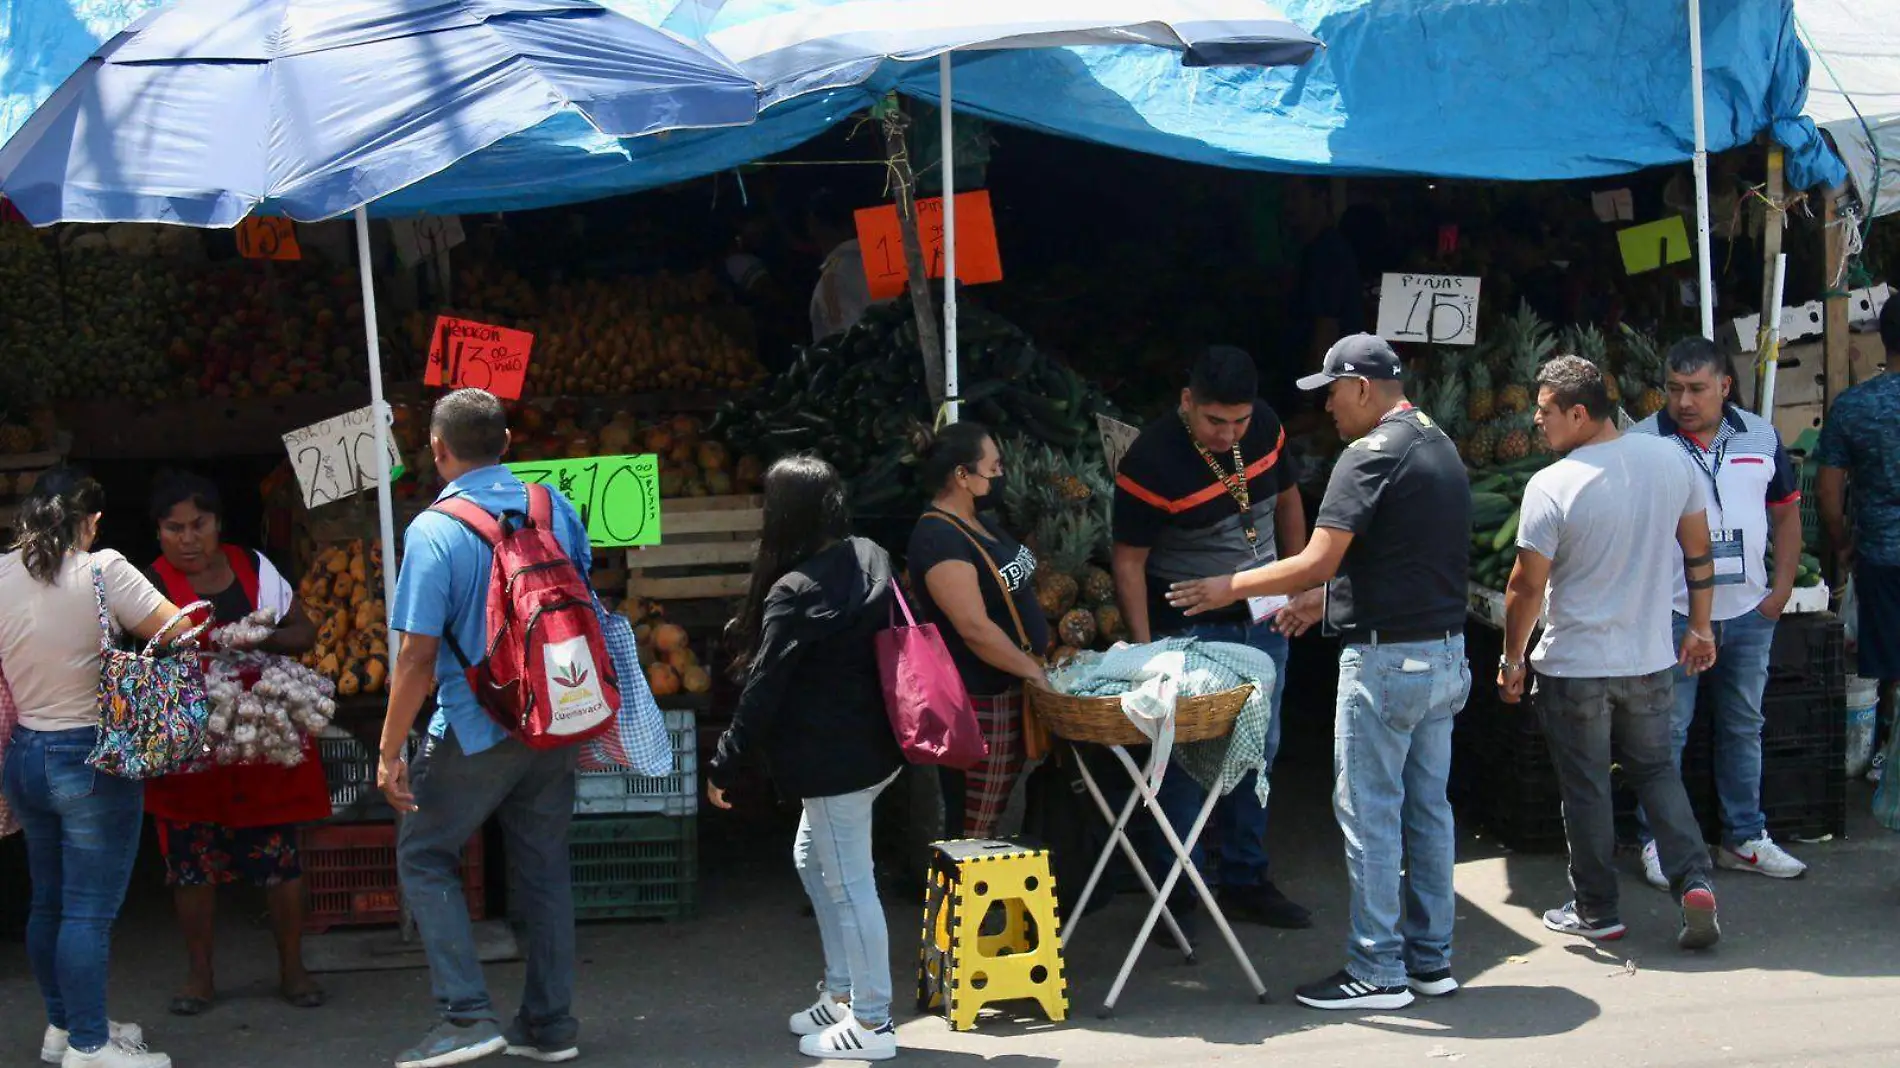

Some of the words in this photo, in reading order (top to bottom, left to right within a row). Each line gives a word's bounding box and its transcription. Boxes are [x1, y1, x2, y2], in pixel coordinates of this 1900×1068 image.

[1395, 290, 1465, 341] 15
[297, 446, 340, 508] 2
[583, 462, 646, 542] 10
